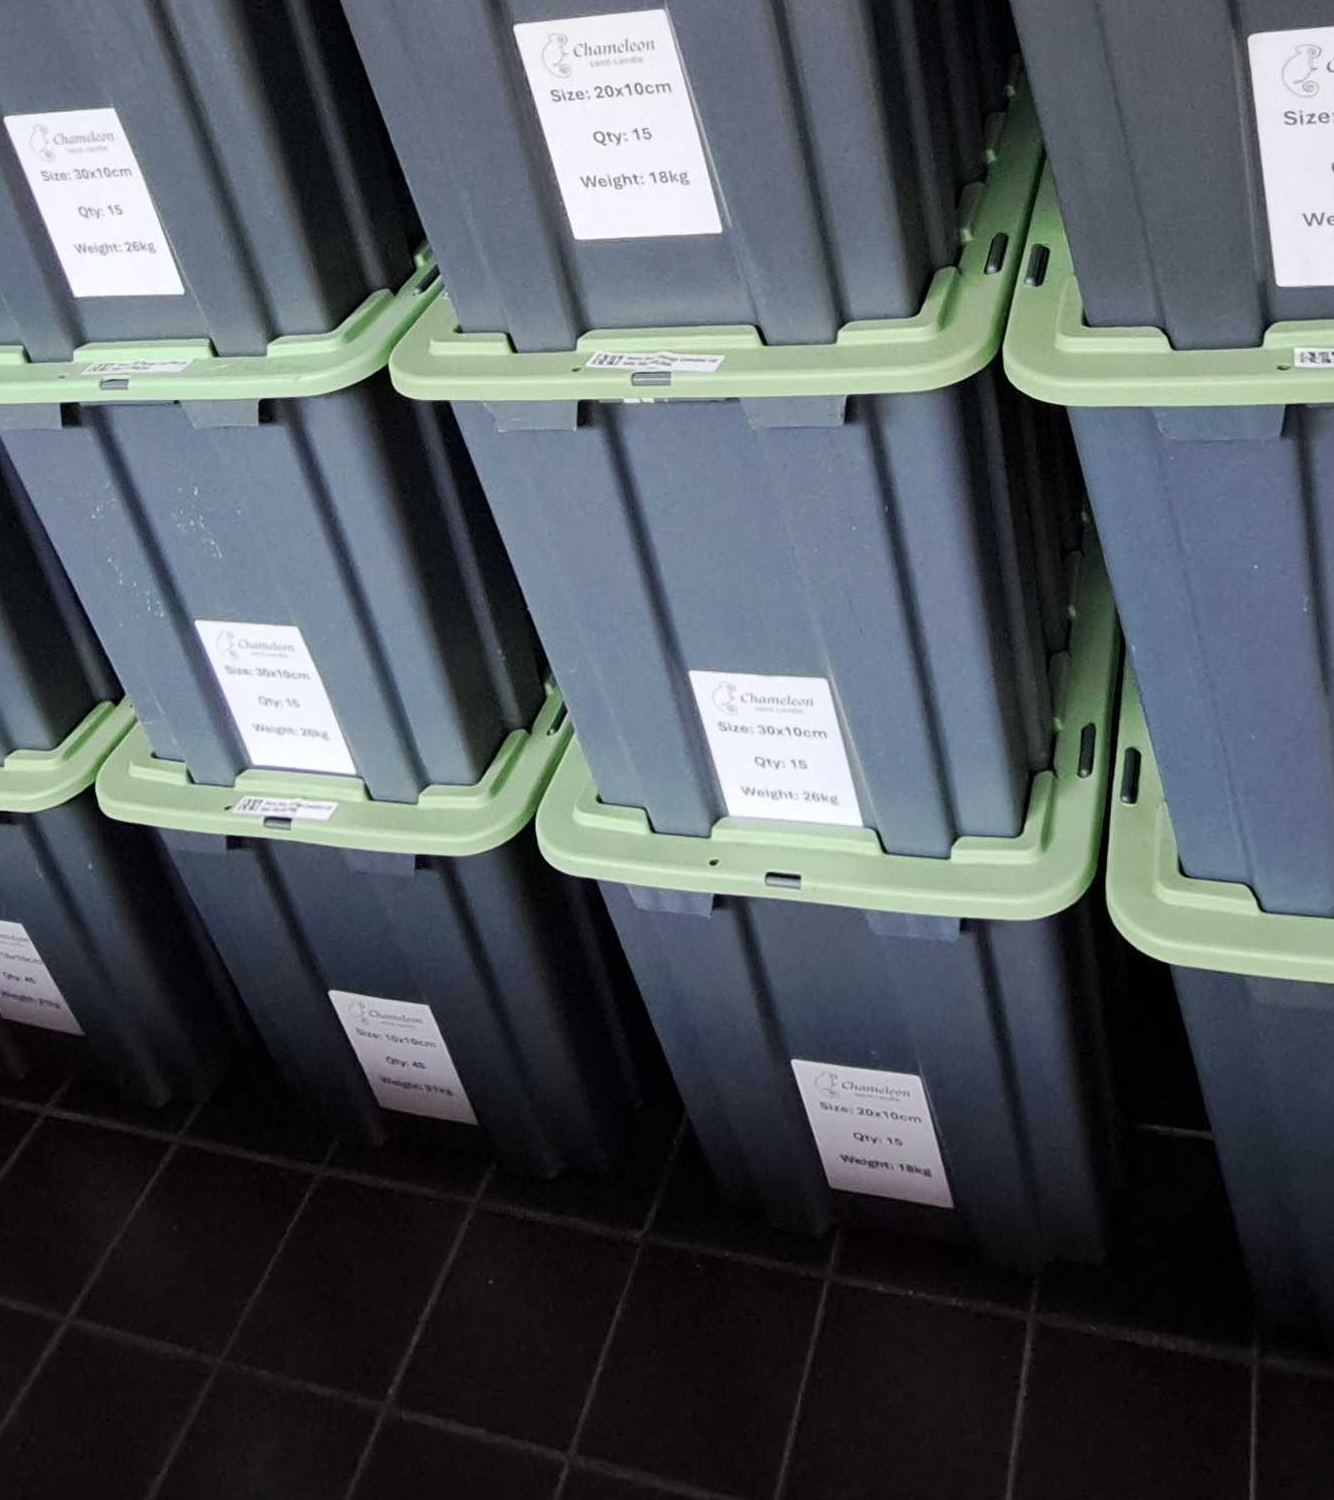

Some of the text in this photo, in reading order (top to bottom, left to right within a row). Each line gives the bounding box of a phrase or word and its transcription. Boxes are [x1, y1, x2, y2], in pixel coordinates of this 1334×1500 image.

[573, 38, 655, 58] Chameleon
[550, 82, 672, 103] Size: 20x10cm
[53, 131, 115, 146] Chameleon
[592, 128, 652, 146] Qty: 15
[41, 167, 133, 182] Size: 30x10cm
[579, 170, 690, 190] Weight: 18kg
[78, 204, 124, 219] Qty: 15
[74, 242, 121, 256] Weight:
[740, 691, 814, 708] Chameleon
[717, 722, 828, 739] Size: 30x10cm
[754, 756, 808, 770] Qty: 15
[740, 786, 839, 806] Weight: 26kg
[841, 1081, 911, 1099] Chameleon
[819, 1101, 922, 1123] Size: 20x10cm
[853, 1131, 903, 1147] Qty: 15
[839, 1153, 895, 1170] Weight:
